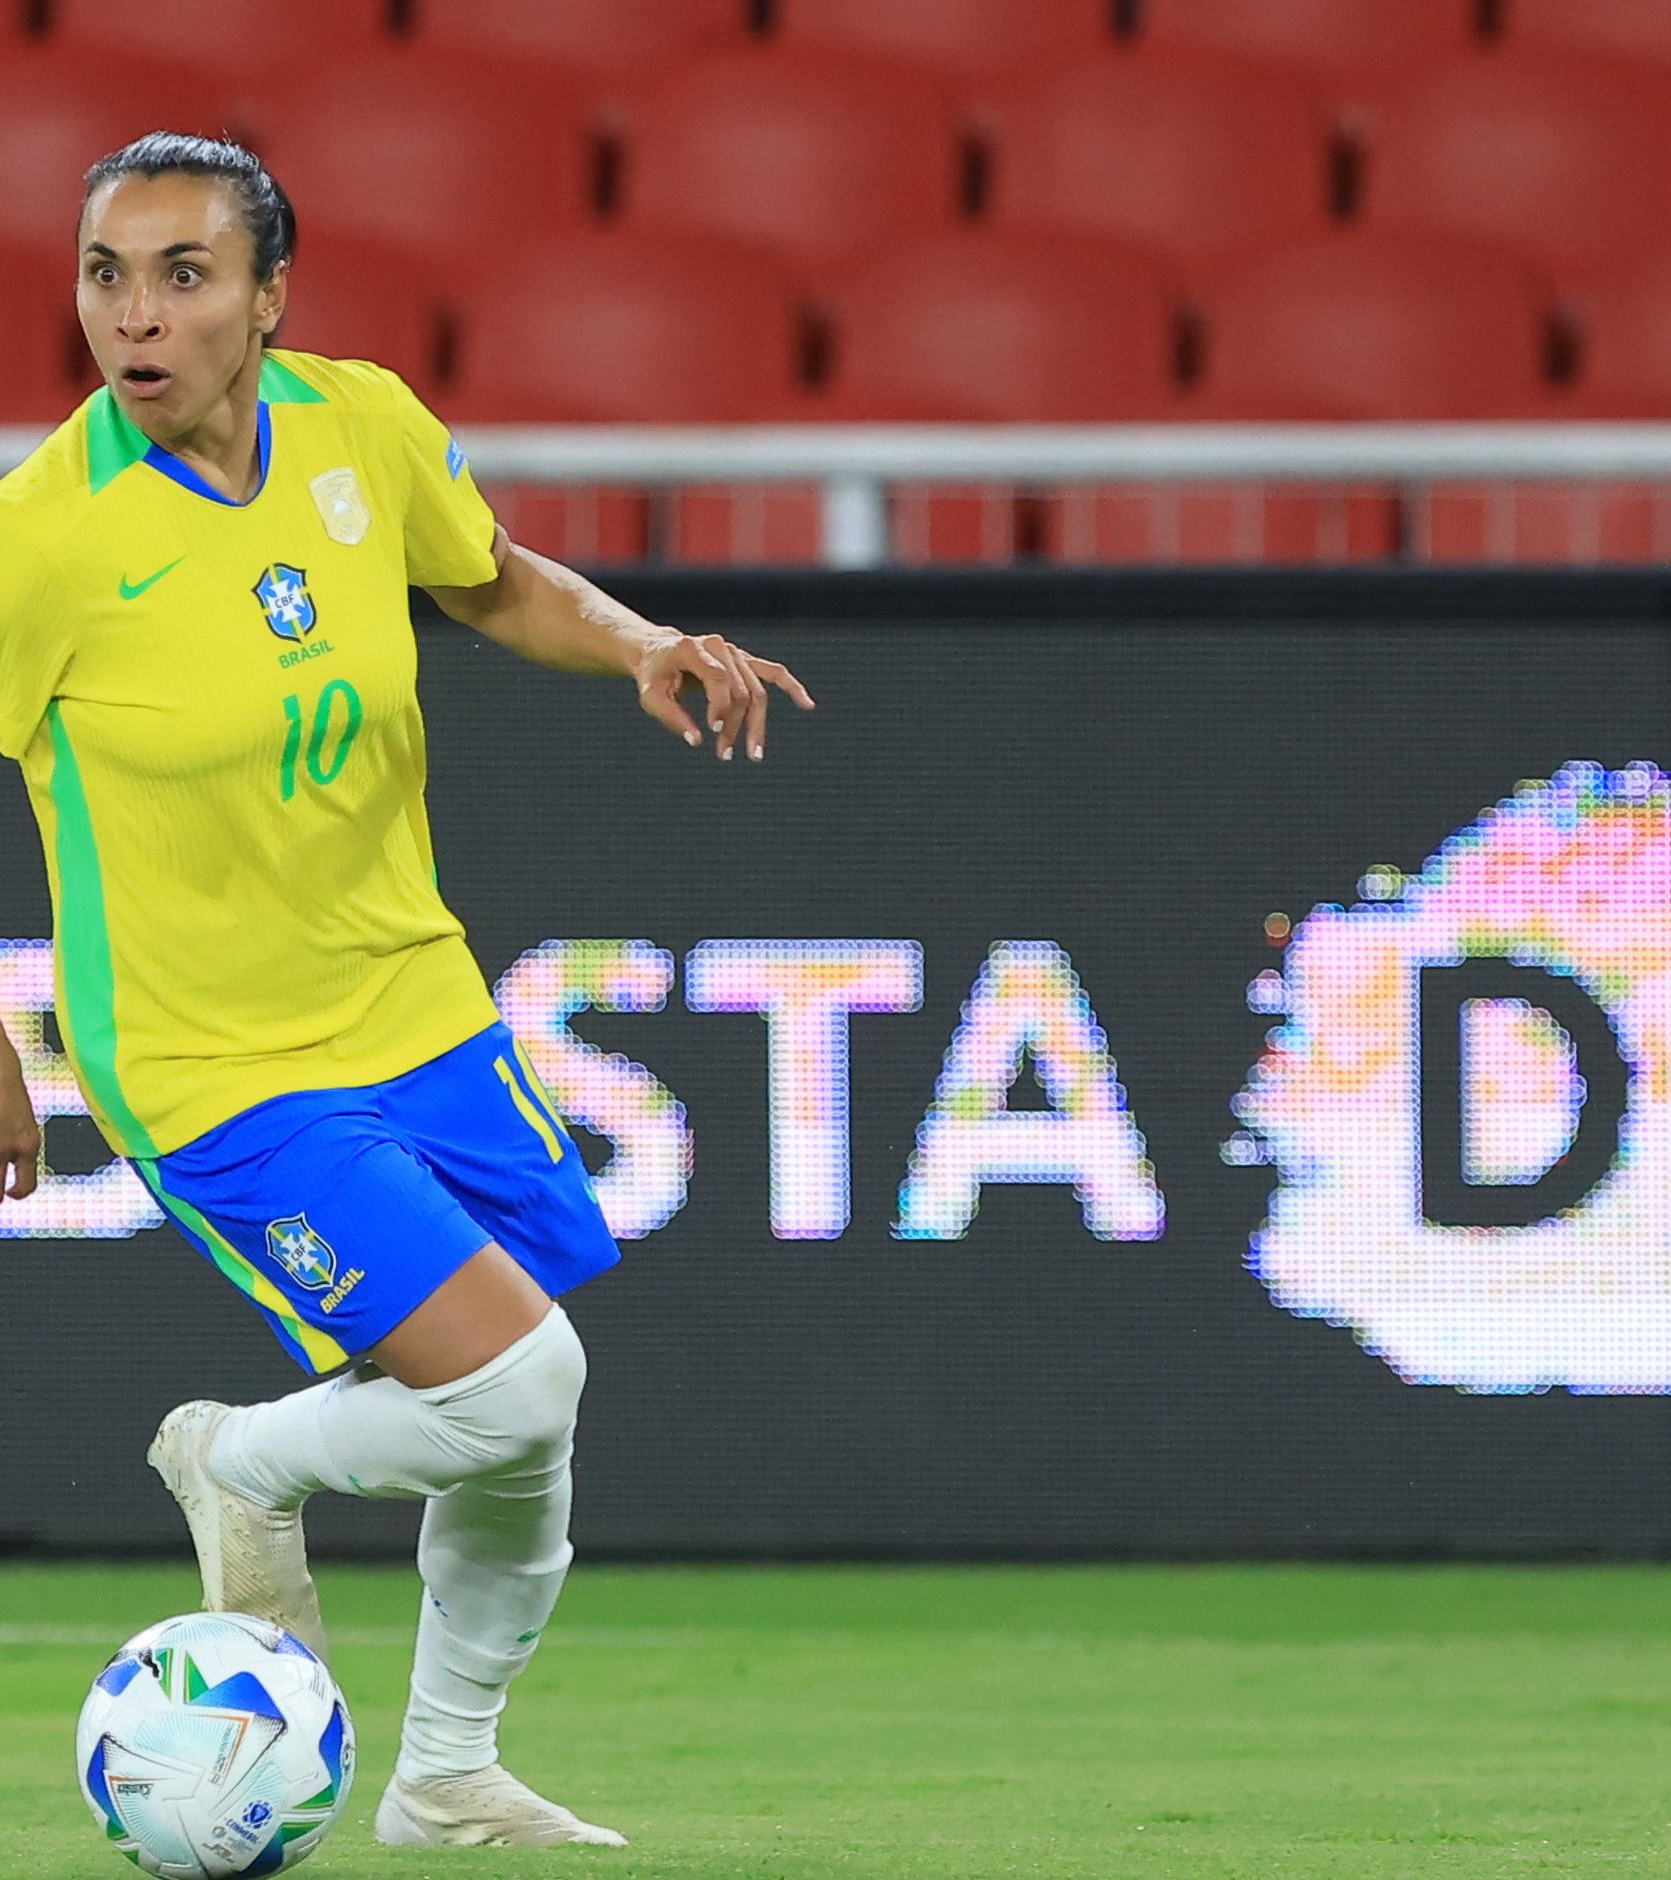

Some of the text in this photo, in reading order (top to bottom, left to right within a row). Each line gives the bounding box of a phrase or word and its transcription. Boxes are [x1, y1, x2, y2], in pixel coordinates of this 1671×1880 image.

[274, 593, 296, 609] CBF
[279, 639, 336, 669] BRASIL
[280, 678, 363, 802] 10
[291, 1243, 307, 1261] CBF
[319, 1267, 366, 1314] BRASIL
